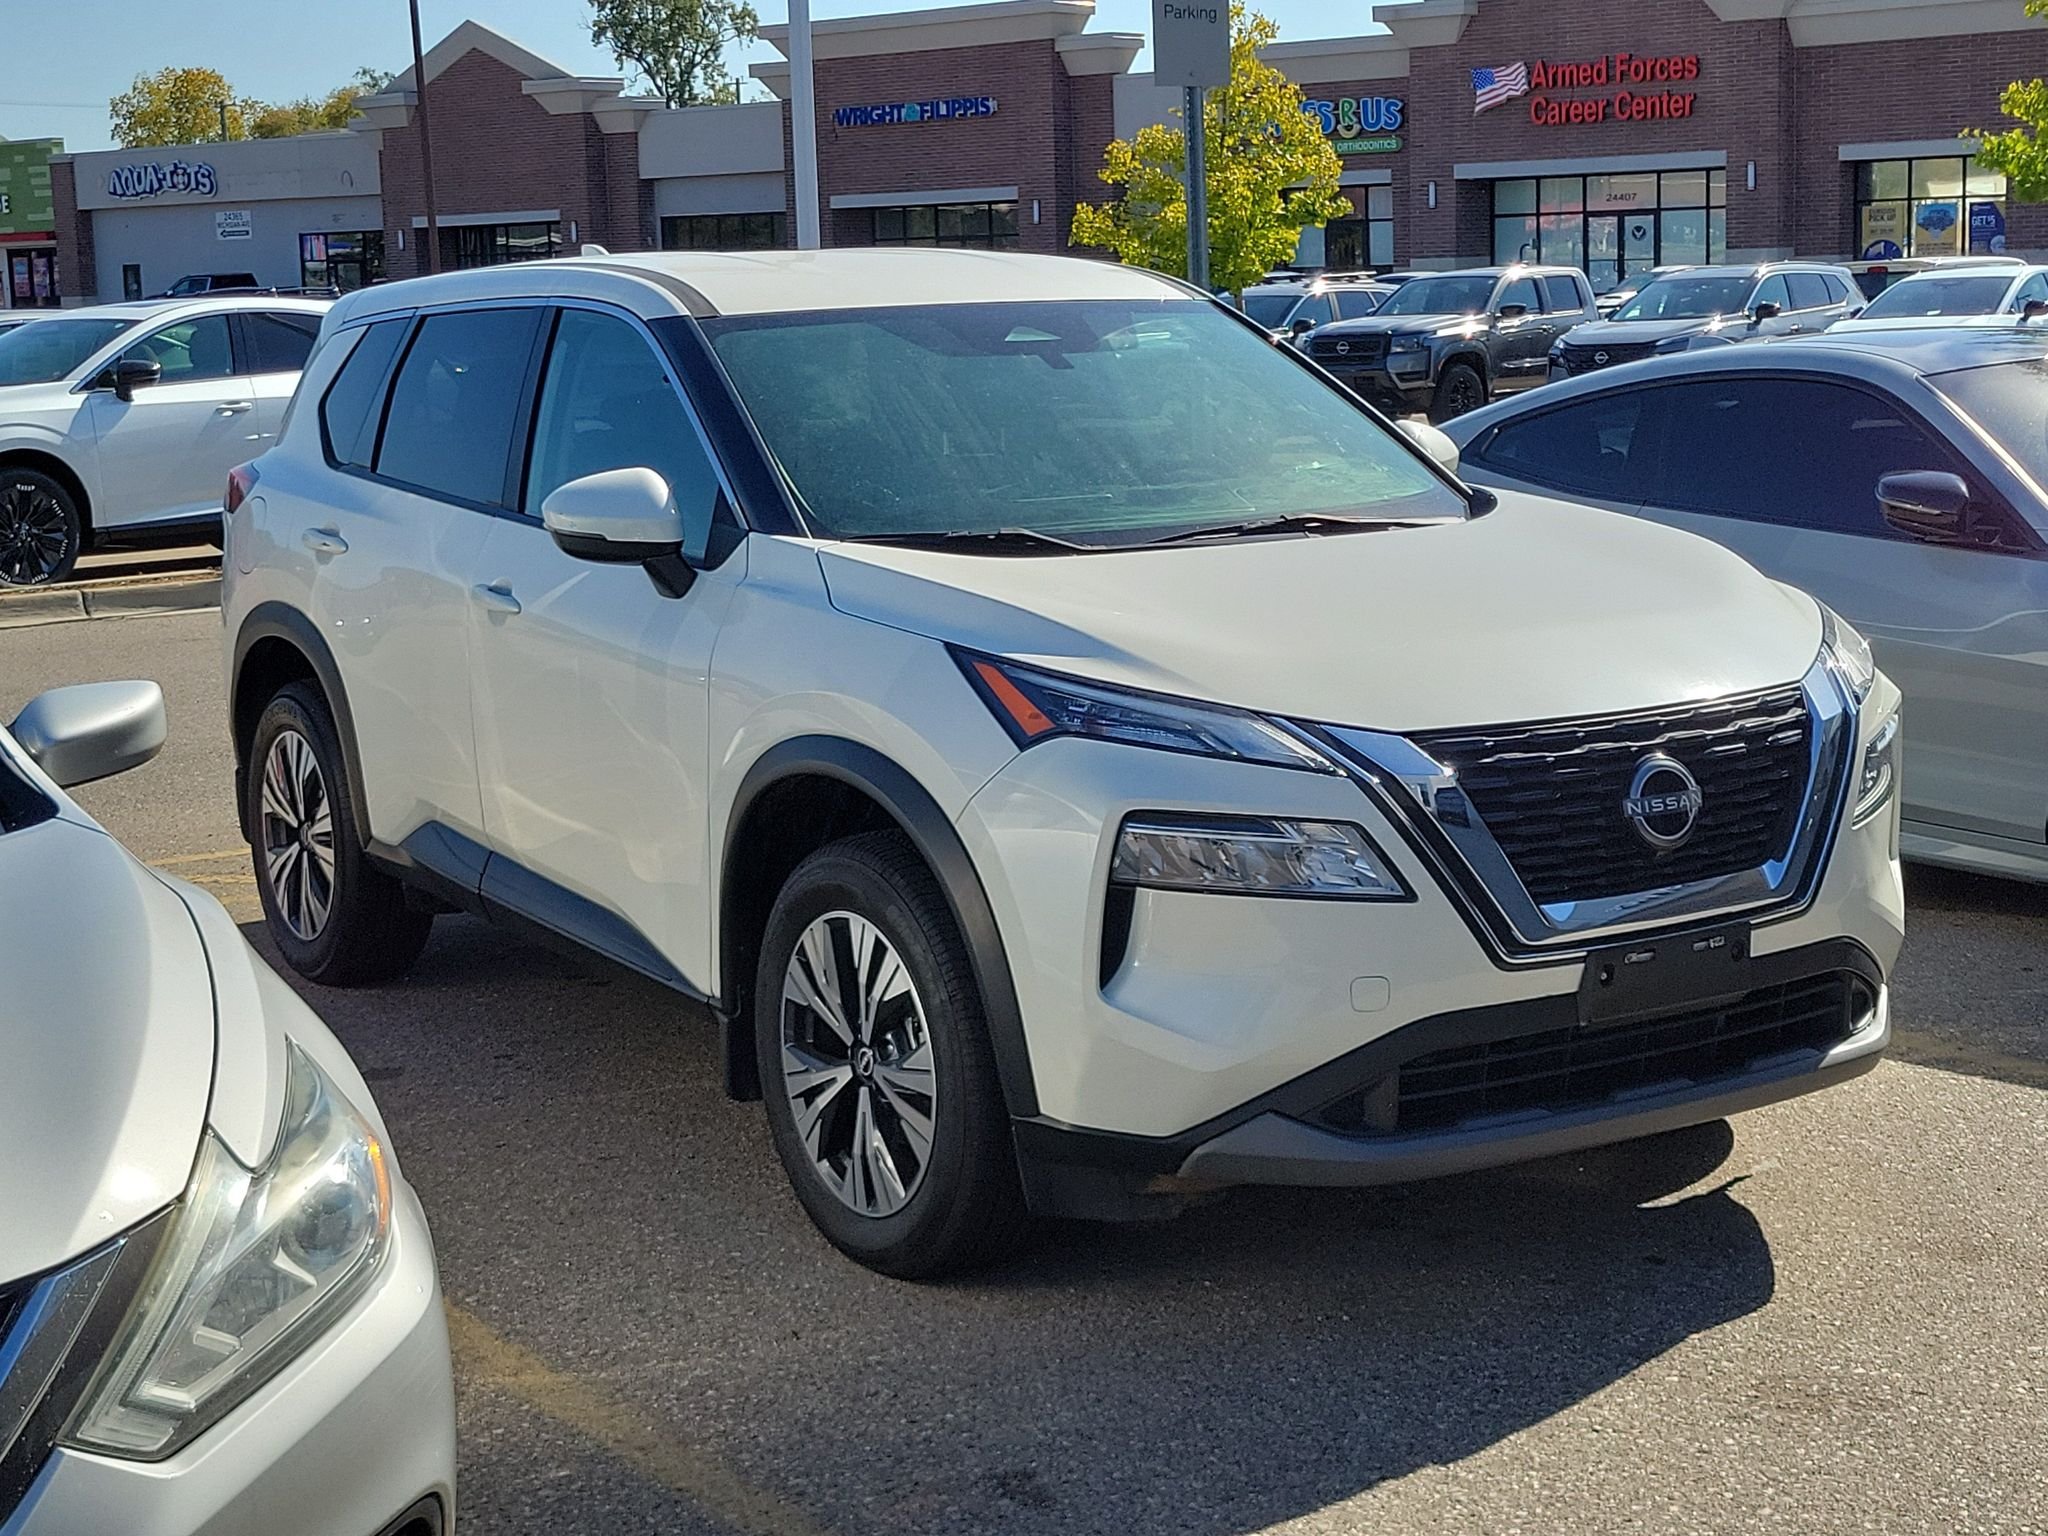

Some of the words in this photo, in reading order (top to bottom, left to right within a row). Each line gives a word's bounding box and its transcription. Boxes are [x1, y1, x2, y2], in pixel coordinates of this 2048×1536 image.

[1164, 3, 1217, 24] Parking
[1531, 56, 1607, 88] Armed
[1615, 53, 1699, 82] Forces
[835, 105, 904, 126] WRIGHT
[920, 97, 993, 120] FILIPPIS
[1300, 99, 1336, 134] ES
[1339, 97, 1356, 126] R
[1360, 96, 1403, 132] US
[1531, 96, 1606, 125] Career
[1614, 92, 1694, 120] Center
[1337, 139, 1397, 153] ORTHODONTICS
[0, 196, 11, 214] E
[1606, 192, 1637, 202] 24407
[1627, 791, 1702, 815] NISSAN
